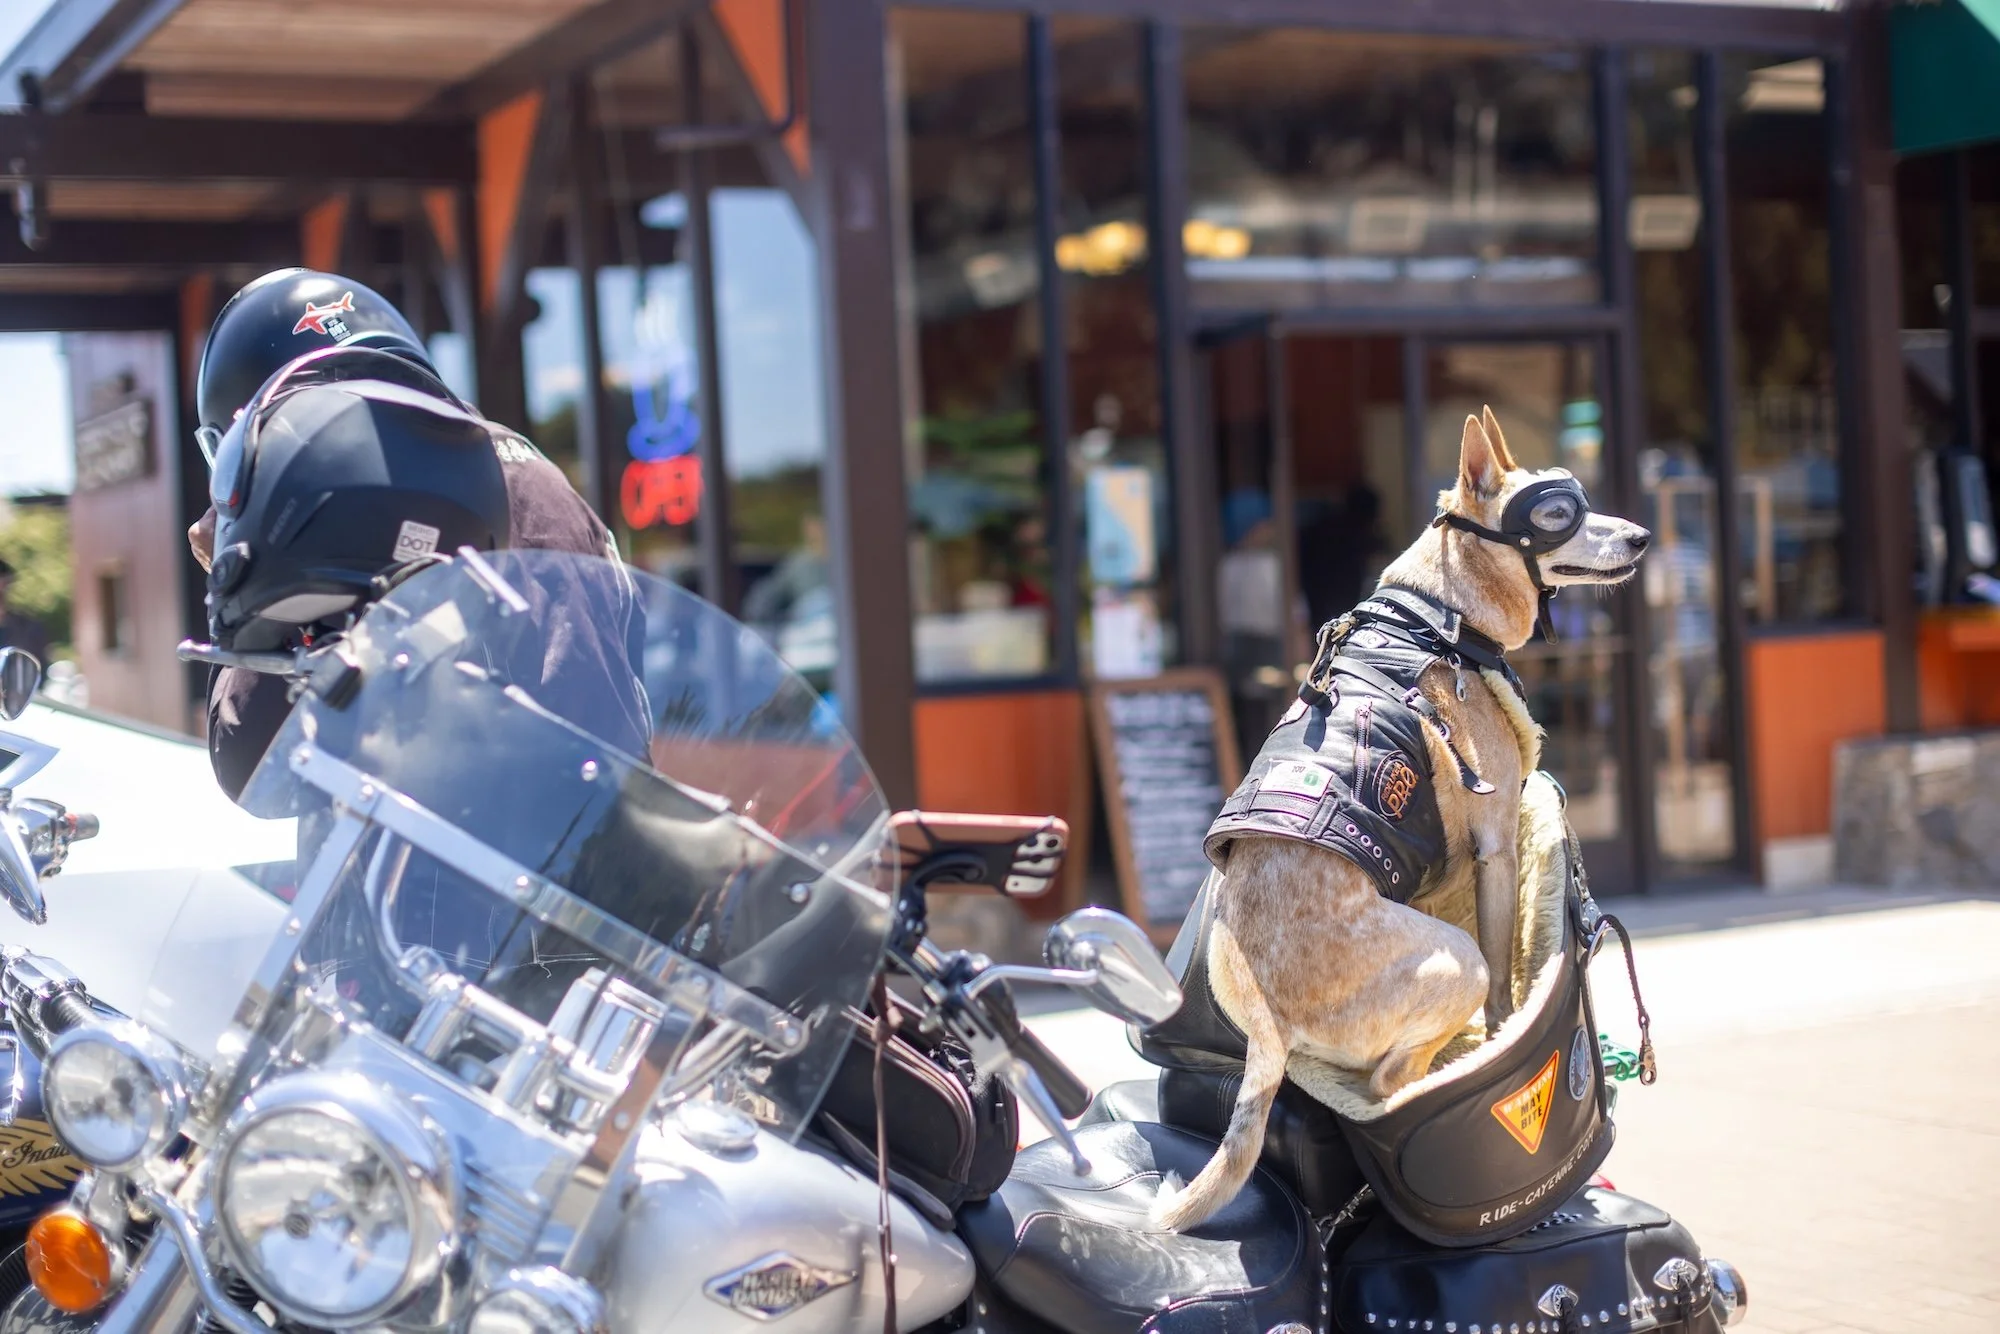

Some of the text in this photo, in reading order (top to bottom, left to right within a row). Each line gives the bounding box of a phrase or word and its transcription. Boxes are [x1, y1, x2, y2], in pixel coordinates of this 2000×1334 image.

[400, 535, 433, 553] DOT
[1503, 1066, 1553, 1115] WARNING
[1521, 1090, 1542, 1117] MAY
[1521, 1104, 1542, 1130] BITE
